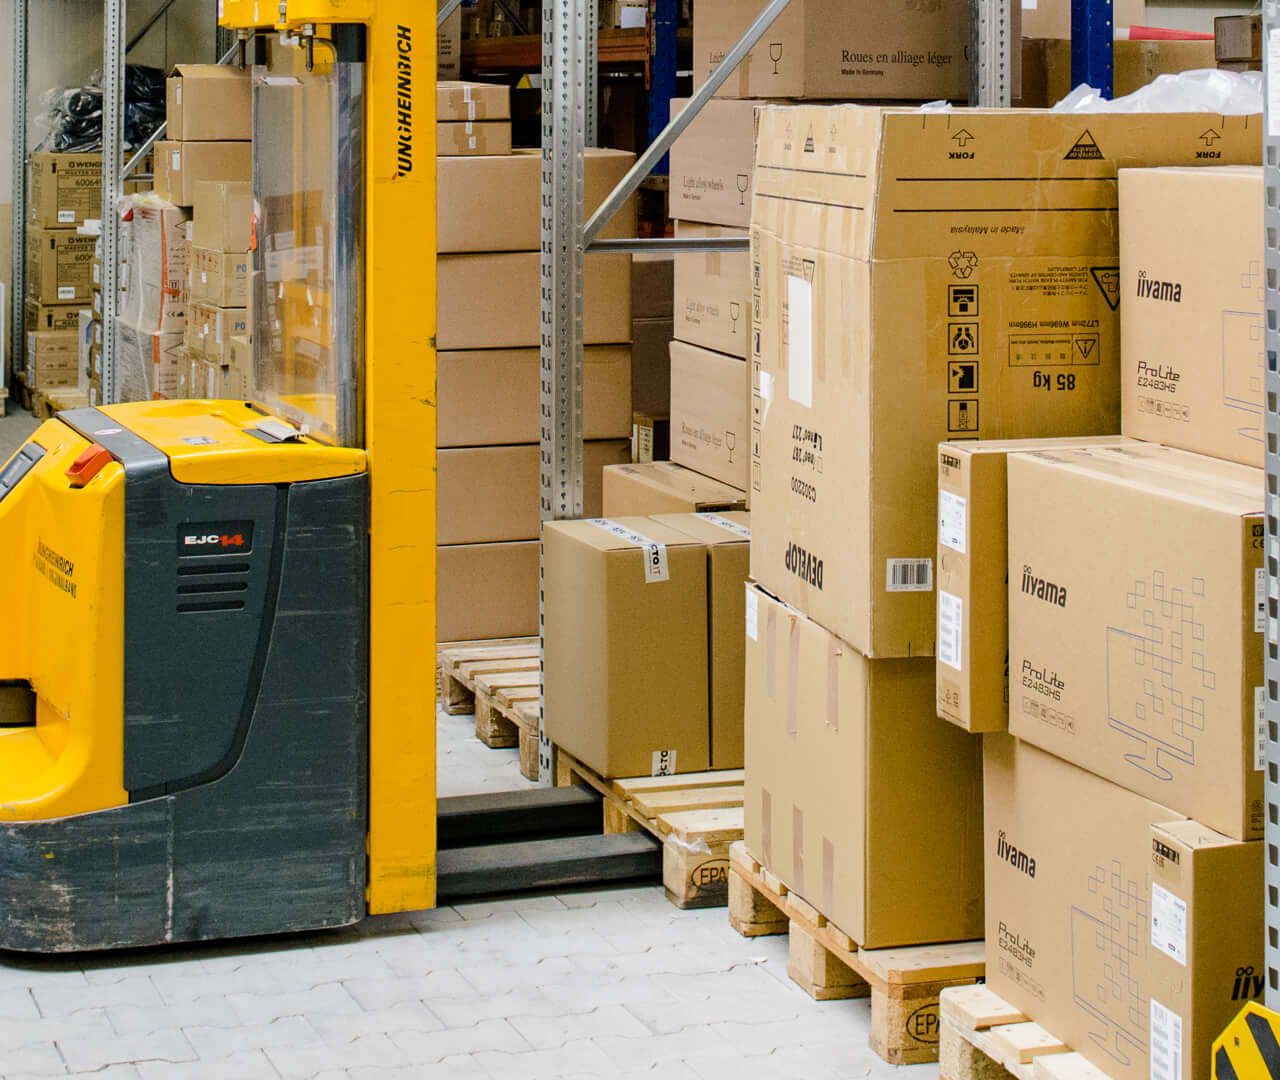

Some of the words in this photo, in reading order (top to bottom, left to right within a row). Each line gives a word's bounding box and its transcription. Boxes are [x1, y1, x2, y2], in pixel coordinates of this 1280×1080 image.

[841, 49, 874, 64] Roues
[875, 53, 889, 64] en
[890, 50, 926, 68] alliage
[926, 50, 953, 68] léger
[948, 151, 975, 160] FORK
[1195, 150, 1222, 159] FORK
[950, 225, 989, 235] Malaysia
[1136, 270, 1182, 303] iiyama
[1032, 370, 1051, 392] kg
[1056, 373, 1076, 391] 85
[1137, 360, 1181, 382] ProLite
[784, 541, 824, 591] DEVELOP
[1022, 564, 1067, 608] iiyama
[1022, 659, 1065, 690] ProLite
[996, 829, 1037, 879] iiyama
[998, 921, 1036, 959] ProLite
[1231, 966, 1265, 1001] iiy
[915, 1013, 939, 1036] EP
